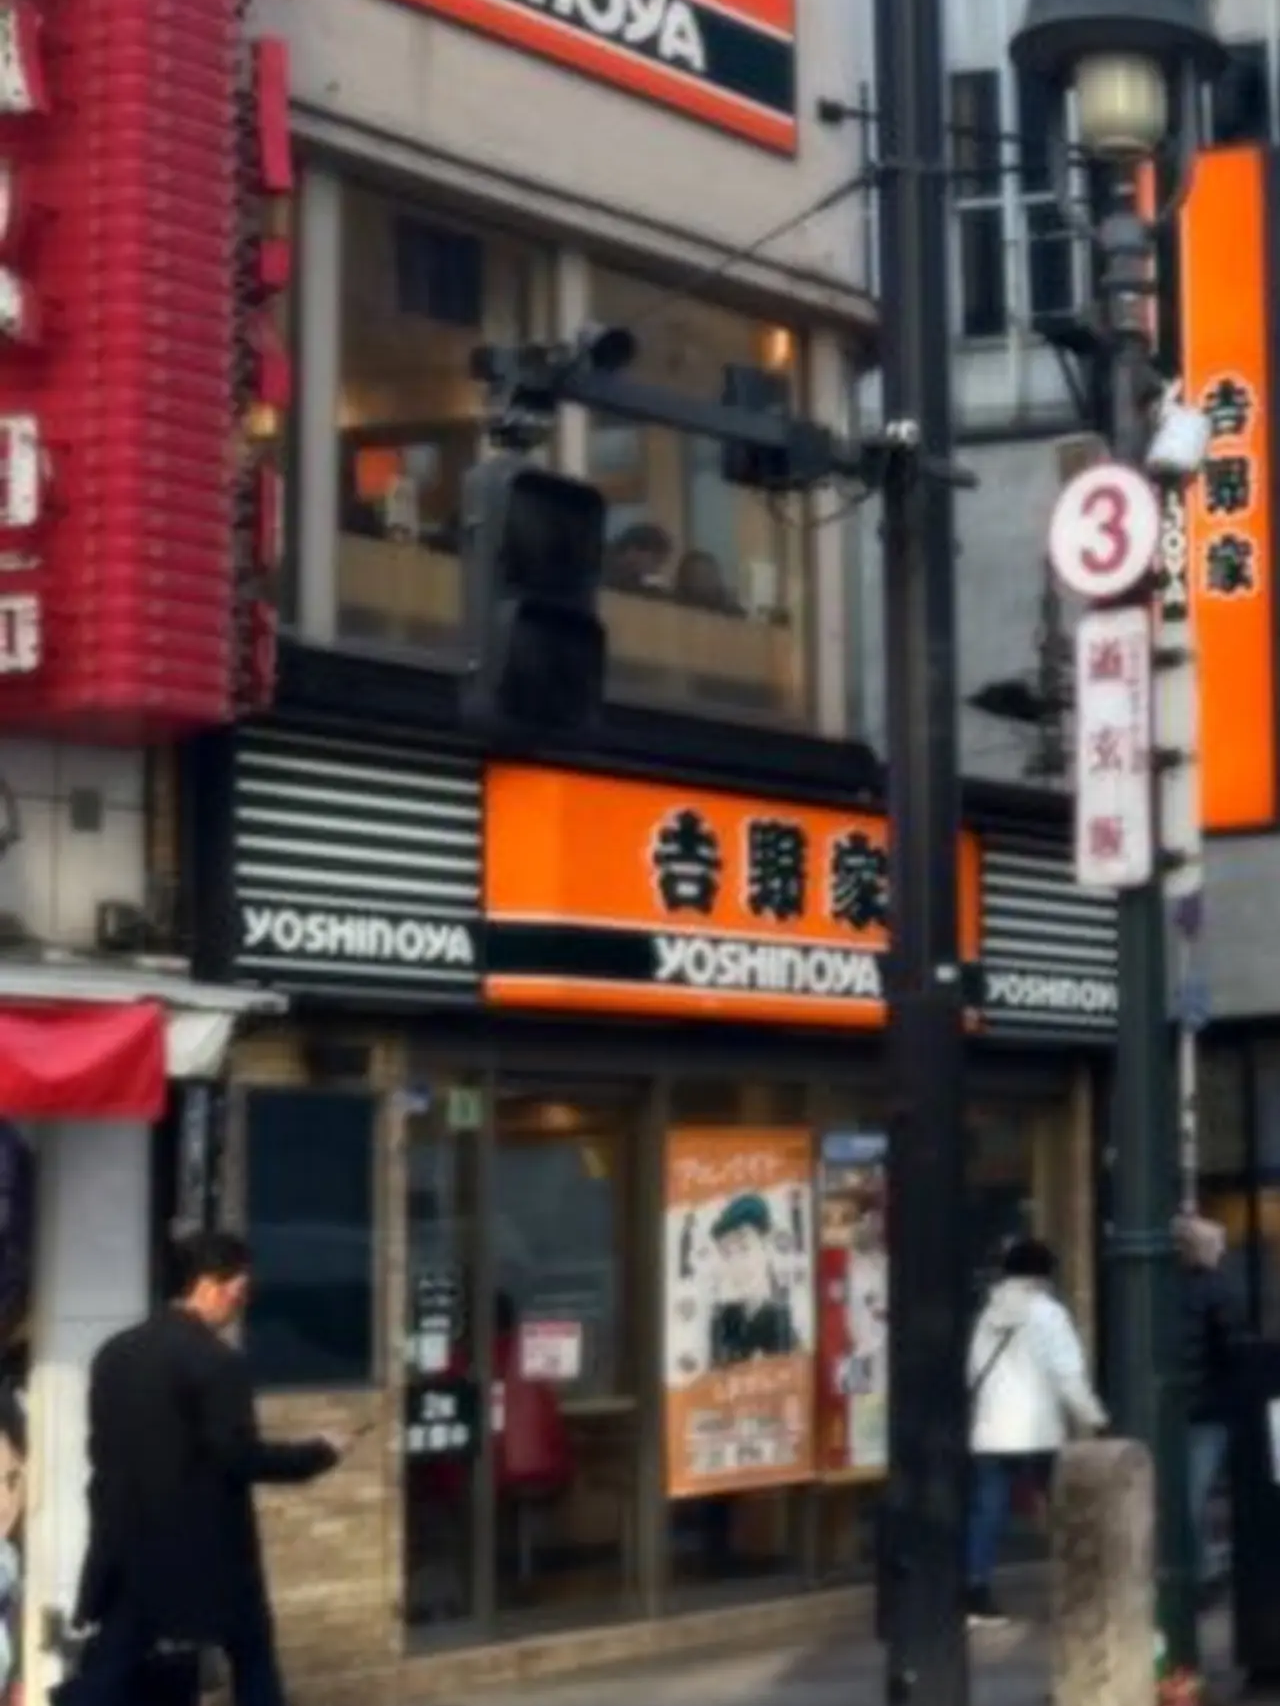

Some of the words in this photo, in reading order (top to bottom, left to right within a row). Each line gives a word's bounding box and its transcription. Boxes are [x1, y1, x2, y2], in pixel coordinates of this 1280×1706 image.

[1079, 485, 1131, 575] 3
[1202, 377, 1255, 594] 吉野家
[651, 805, 889, 933] 吉野家
[243, 907, 474, 964] YOSHINOYA
[651, 935, 882, 996] YOSHINOYA
